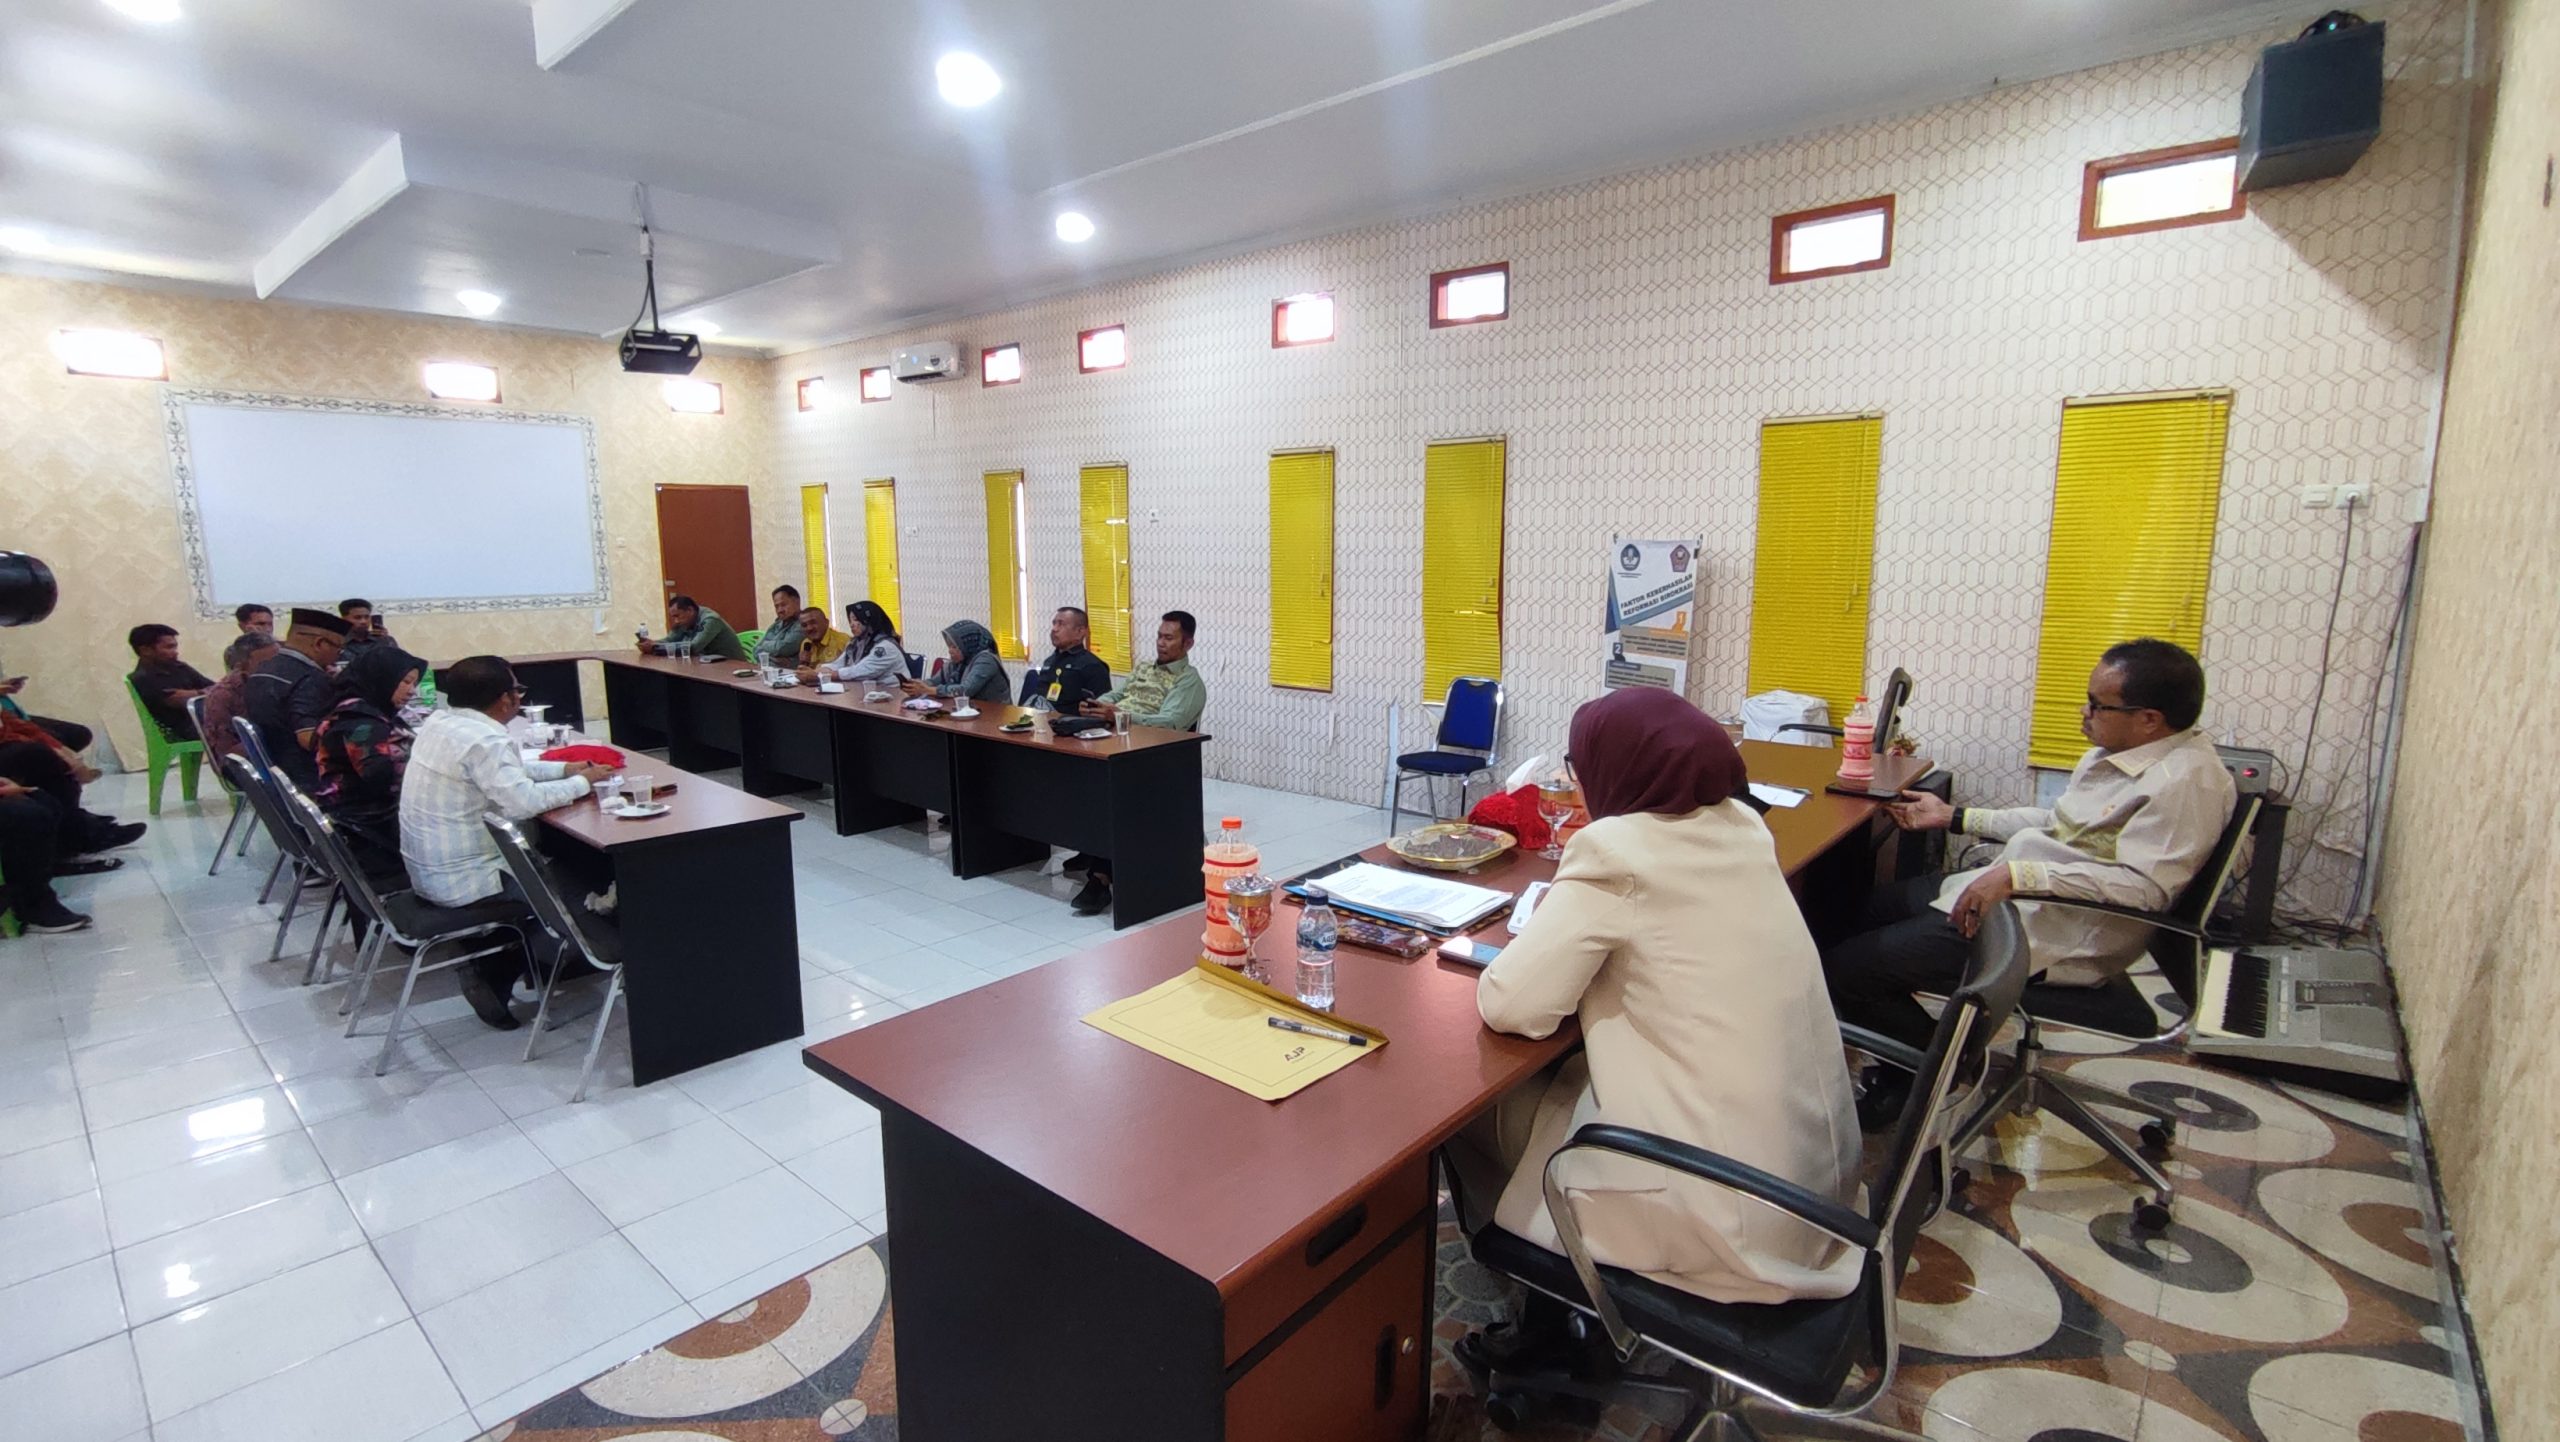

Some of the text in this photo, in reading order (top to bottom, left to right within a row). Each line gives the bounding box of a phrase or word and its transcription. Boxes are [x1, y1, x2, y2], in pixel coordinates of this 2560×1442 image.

[1621, 573, 1693, 608] FAKTOR KEBERHASILAN
[1623, 582, 1693, 616] REFORMASI BIROKRASI
[1615, 645, 1621, 654] 2
